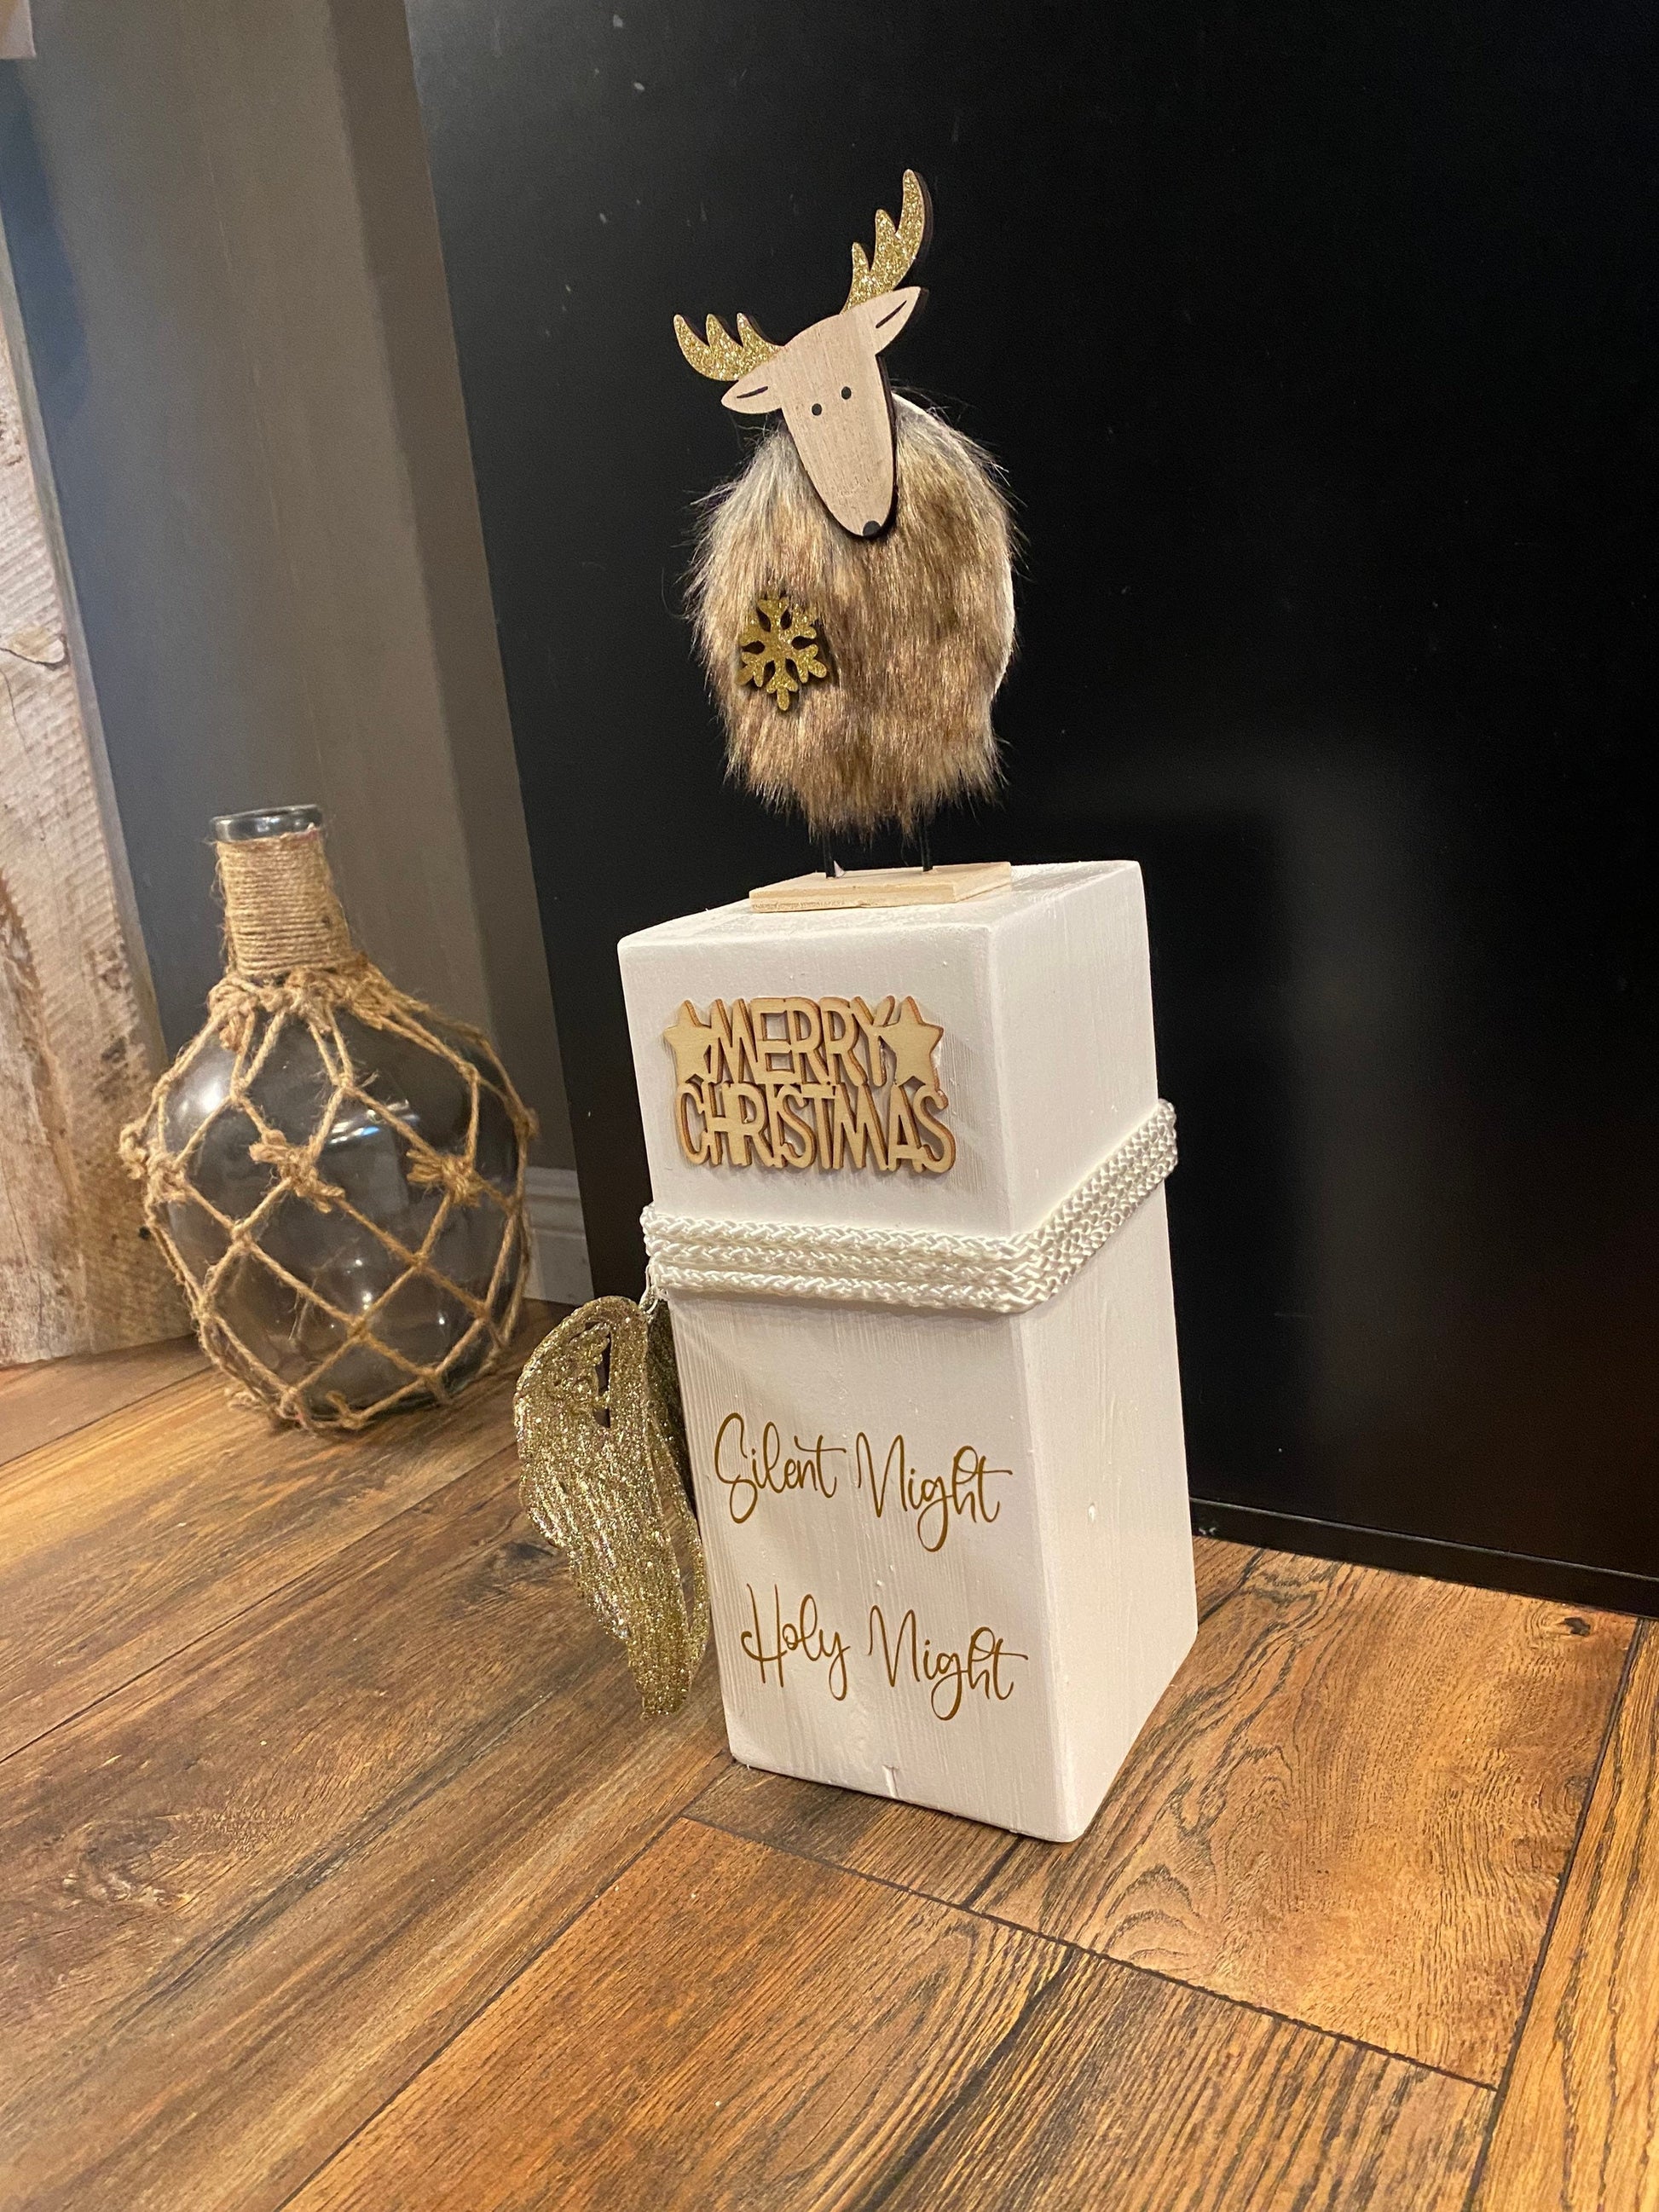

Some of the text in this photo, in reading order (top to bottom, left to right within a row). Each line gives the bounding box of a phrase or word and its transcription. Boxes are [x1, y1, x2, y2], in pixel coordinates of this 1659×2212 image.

[708, 996, 895, 1087] MERRY
[676, 1082, 957, 1174] CHRISTMAS
[714, 1412, 1014, 1552] Silent Night
[741, 1583, 1029, 1721] Holy Night
